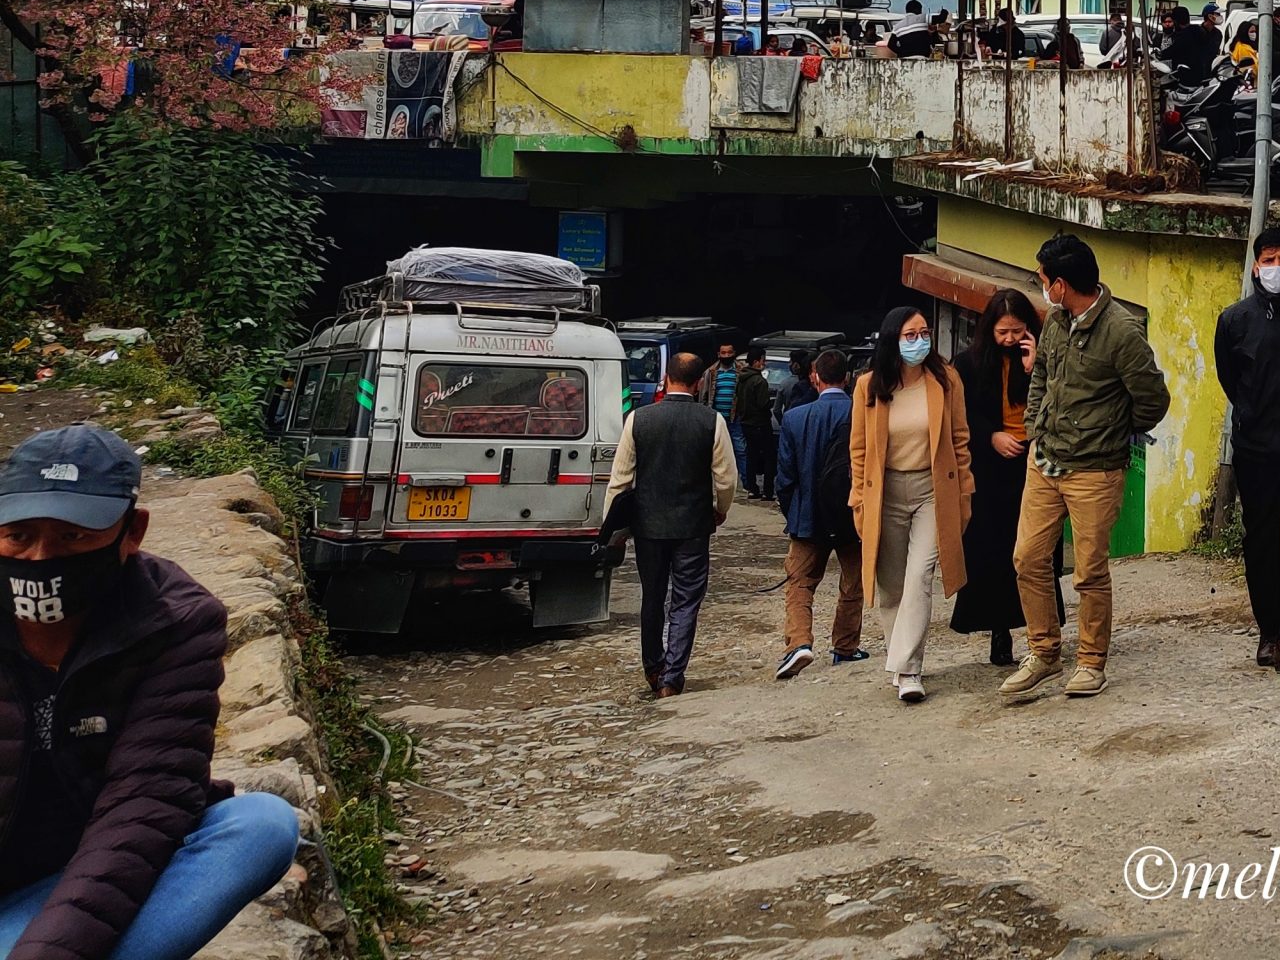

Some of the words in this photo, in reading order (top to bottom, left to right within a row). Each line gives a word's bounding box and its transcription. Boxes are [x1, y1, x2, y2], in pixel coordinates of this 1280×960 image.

[374, 90, 385, 136] chinese
[456, 334, 554, 352] MR.NAMTHANG
[425, 488, 456, 501] SK04
[420, 504, 458, 517] J1033
[9, 576, 63, 599] WOLF
[14, 596, 64, 624] 88
